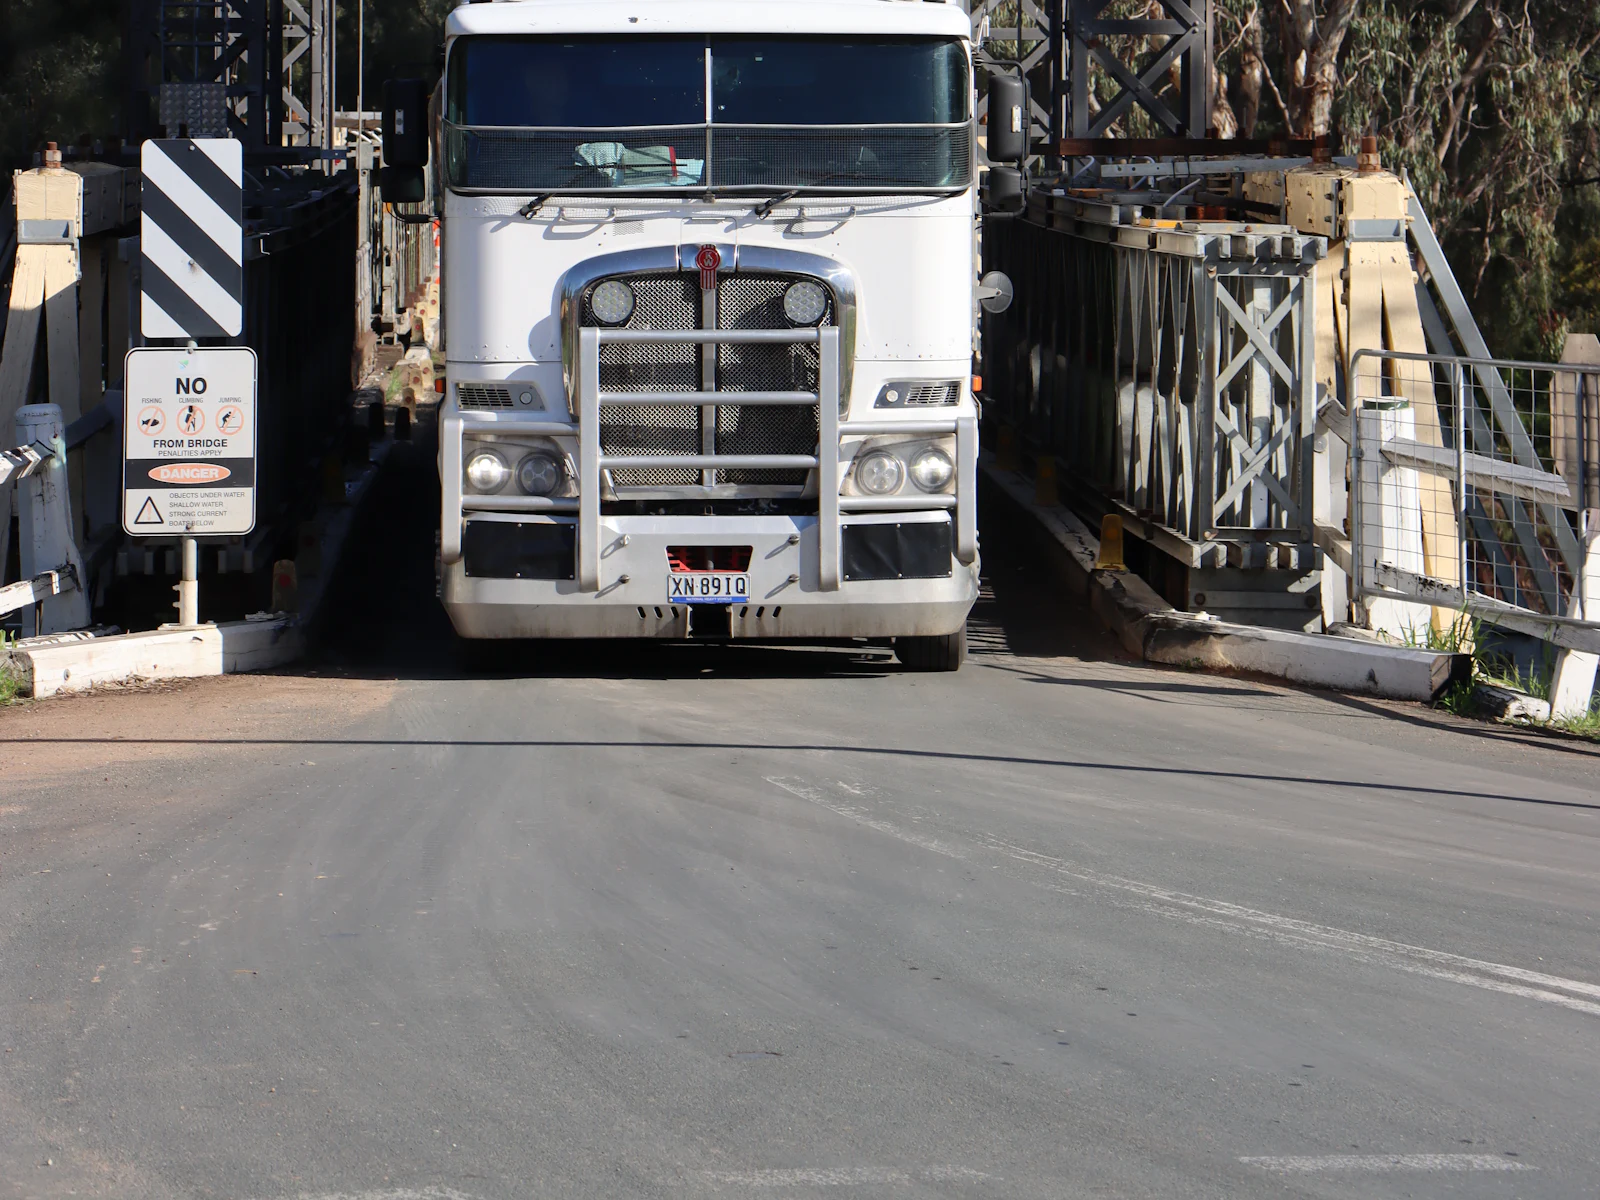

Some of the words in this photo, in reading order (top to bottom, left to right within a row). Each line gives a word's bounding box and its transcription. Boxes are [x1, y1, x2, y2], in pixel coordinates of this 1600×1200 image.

[176, 377, 207, 395] NO
[153, 440, 184, 448] FROM
[188, 439, 228, 447] BRIDGE
[160, 468, 219, 479] DANGER
